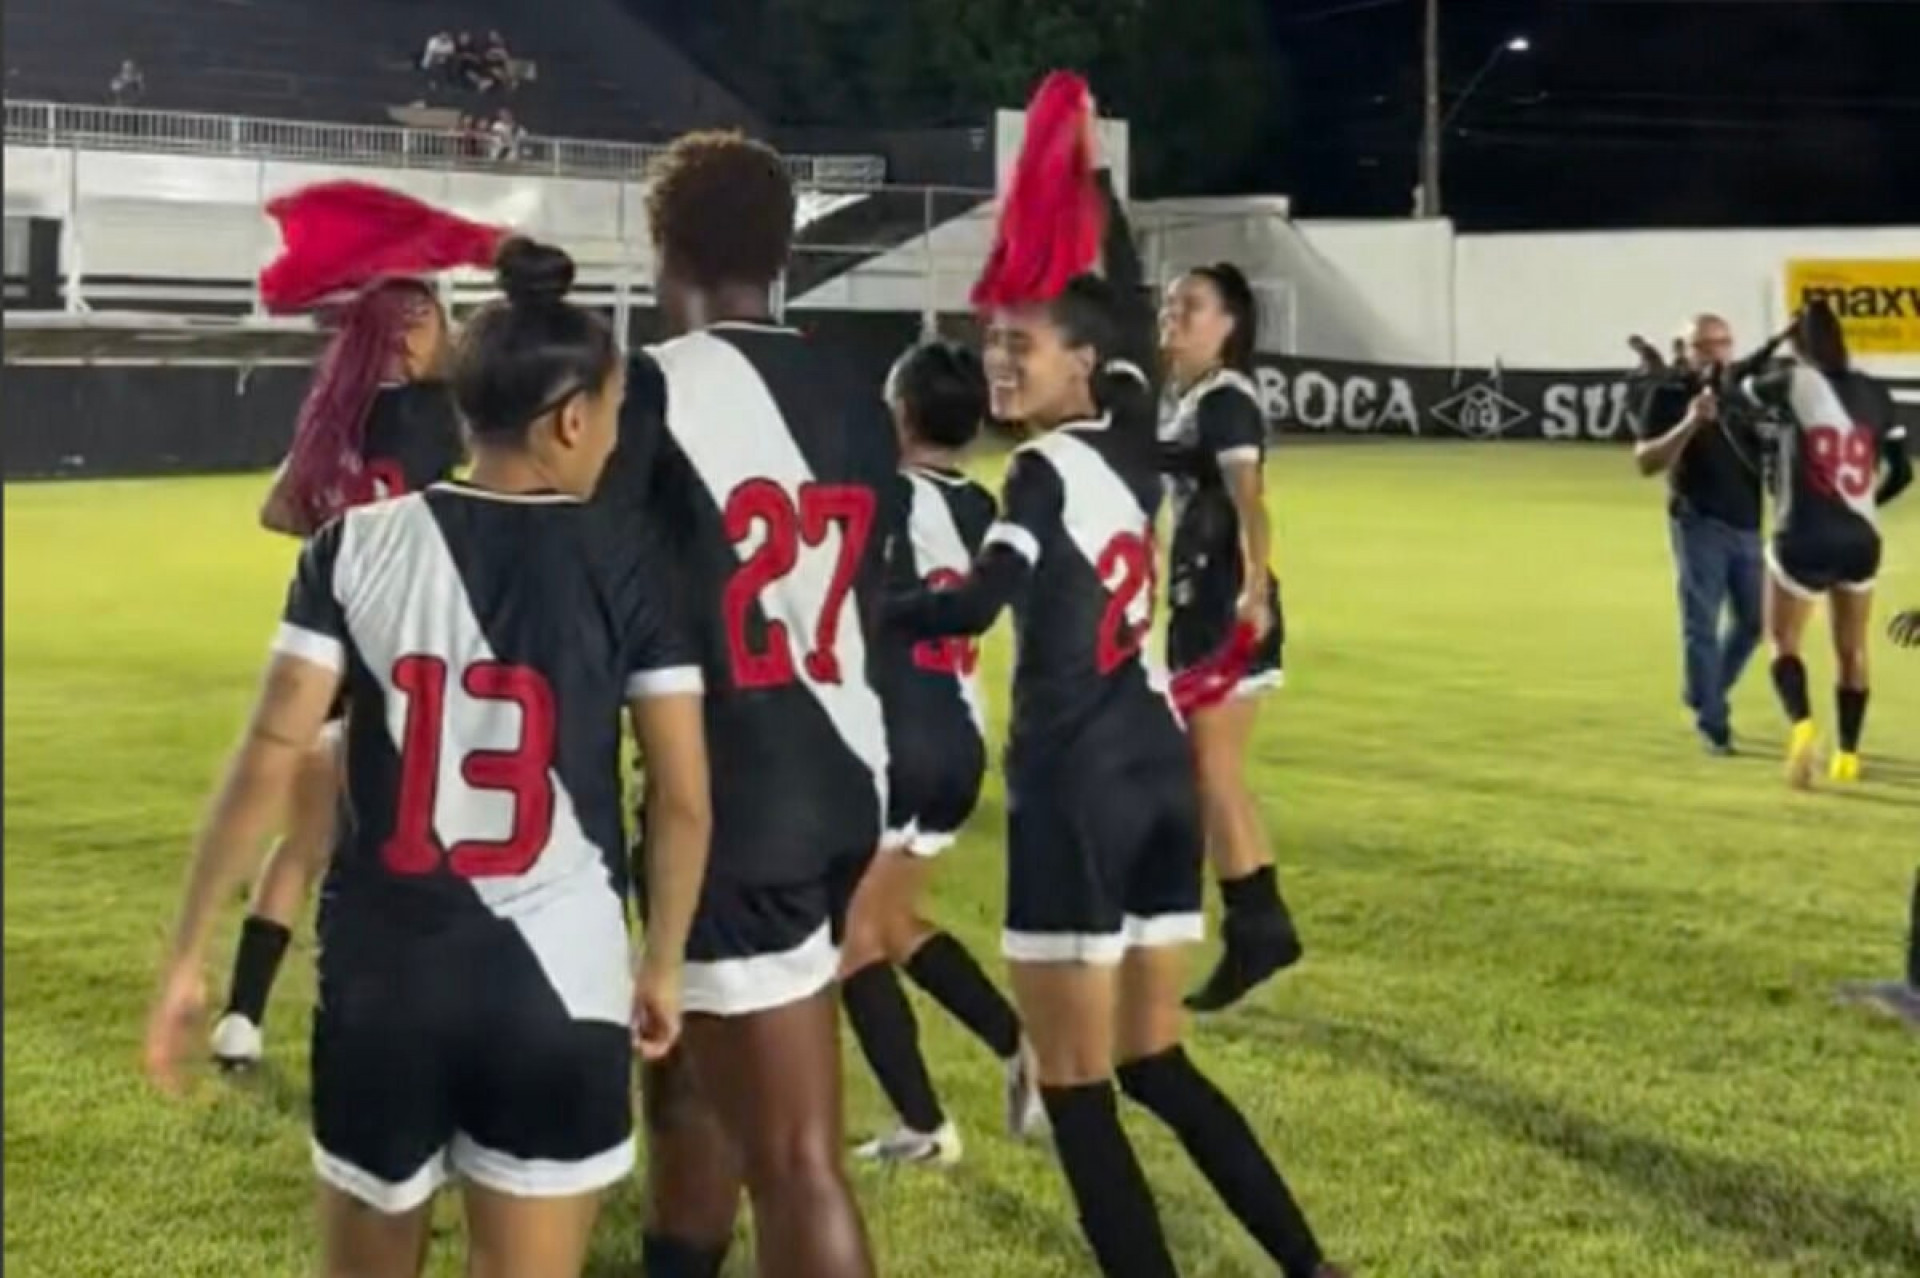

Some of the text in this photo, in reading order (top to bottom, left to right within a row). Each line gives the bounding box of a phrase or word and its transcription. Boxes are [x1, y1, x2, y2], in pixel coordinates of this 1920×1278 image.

[1254, 366, 1419, 435] BOCA
[722, 477, 877, 689] 27
[381, 653, 556, 877] 13
